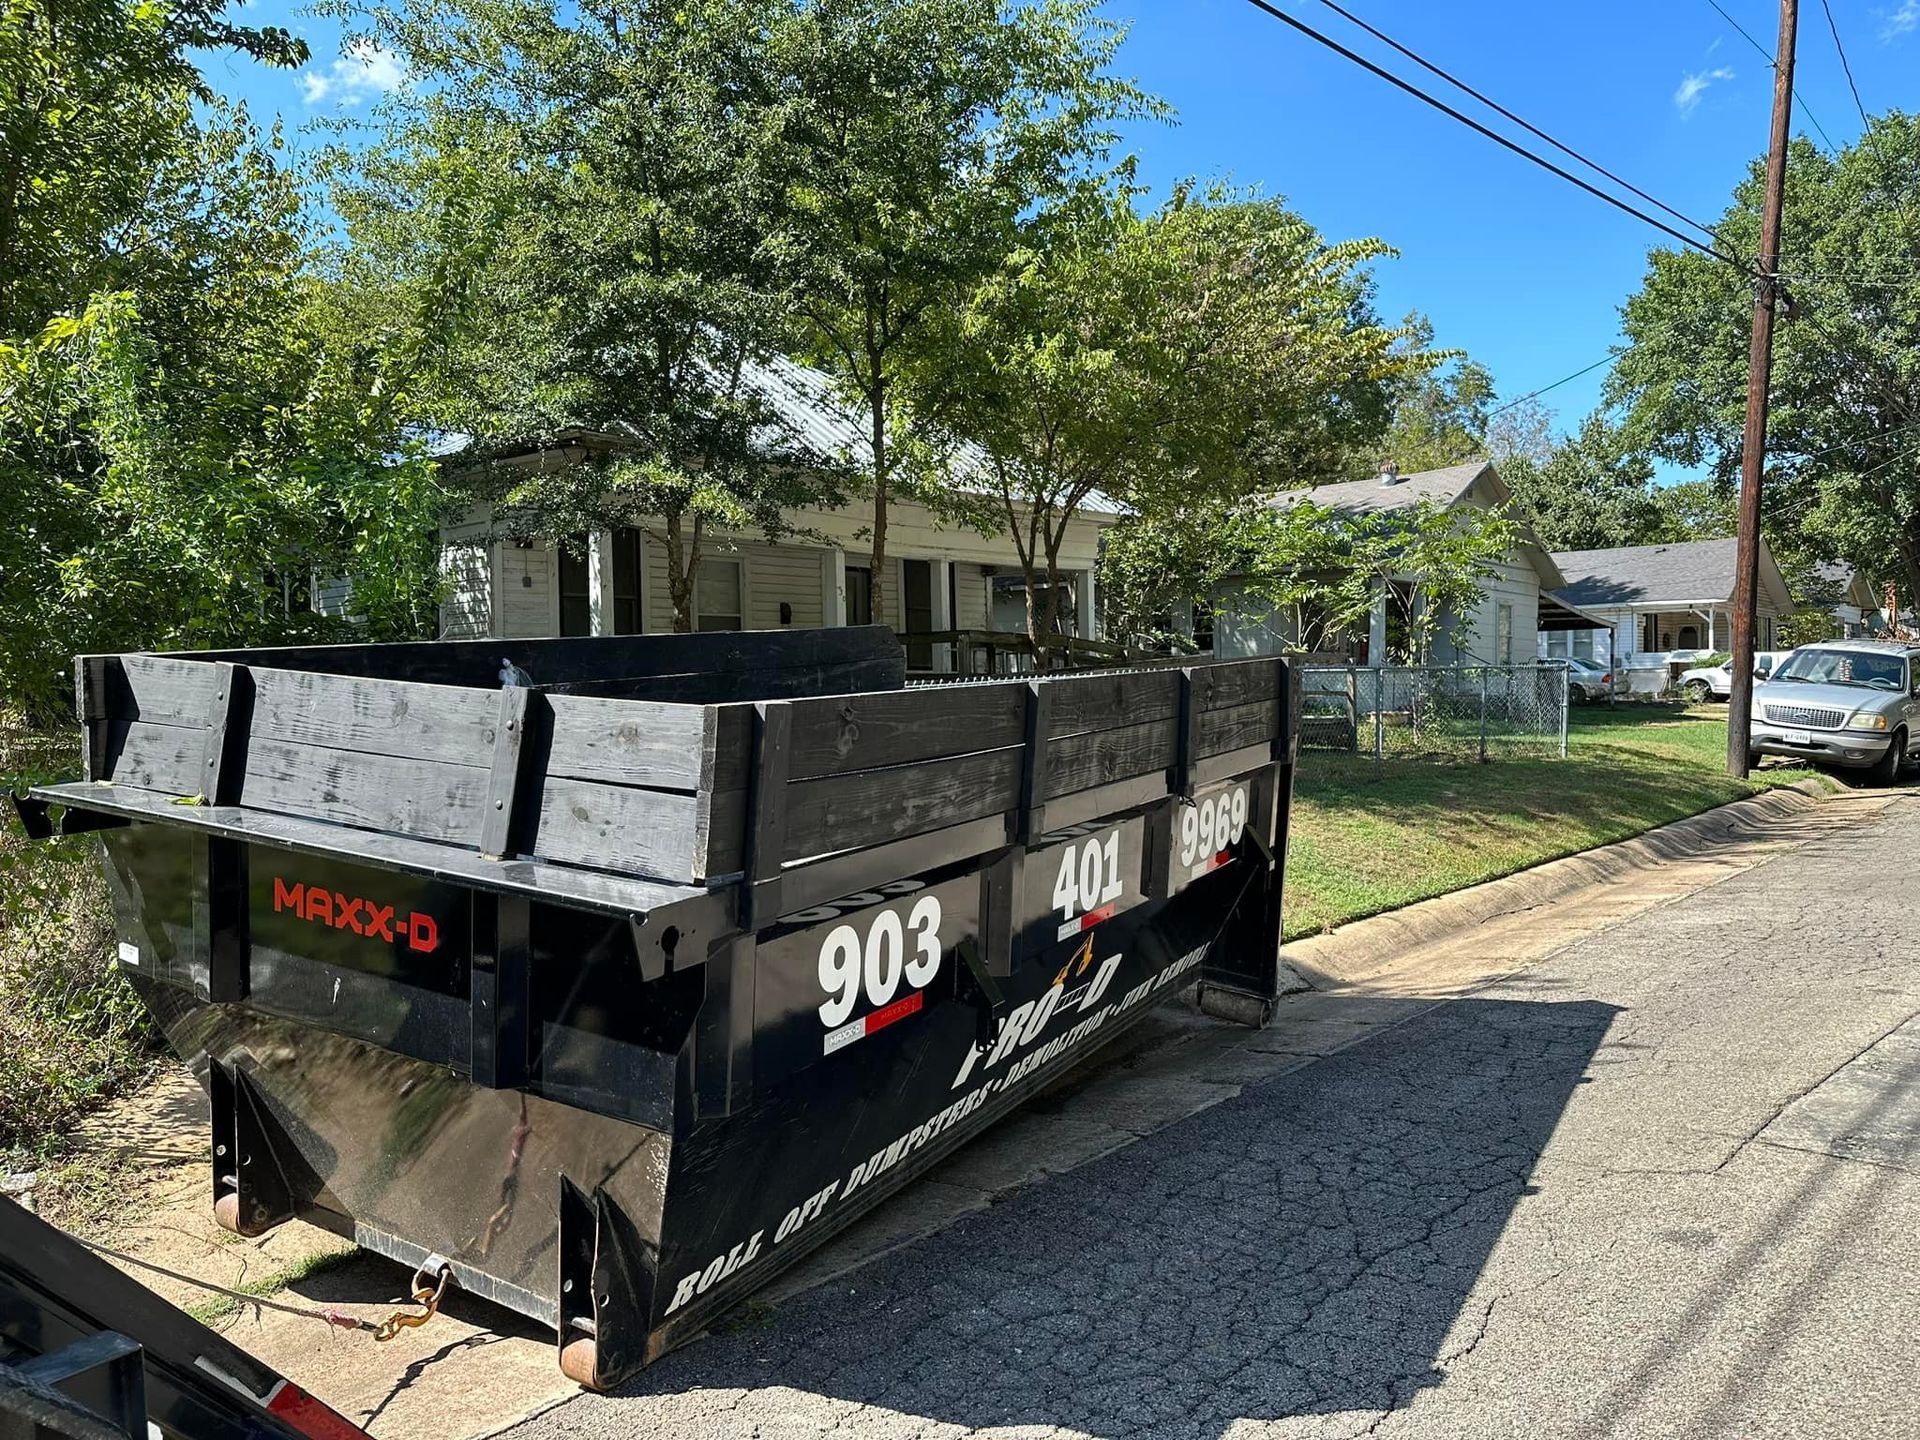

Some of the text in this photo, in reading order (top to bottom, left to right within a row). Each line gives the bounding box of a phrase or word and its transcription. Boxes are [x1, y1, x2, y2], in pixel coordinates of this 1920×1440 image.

[274, 877, 437, 953] MAXX-D
[818, 788, 1246, 1028] 903 401 9969
[828, 1024, 861, 1047] MAXX-D
[664, 1230, 764, 1316] ROLL
[774, 1179, 841, 1243] OFF
[839, 1079, 994, 1200] DUMPSTERS
[999, 1003, 1113, 1092] DEMOLITION
